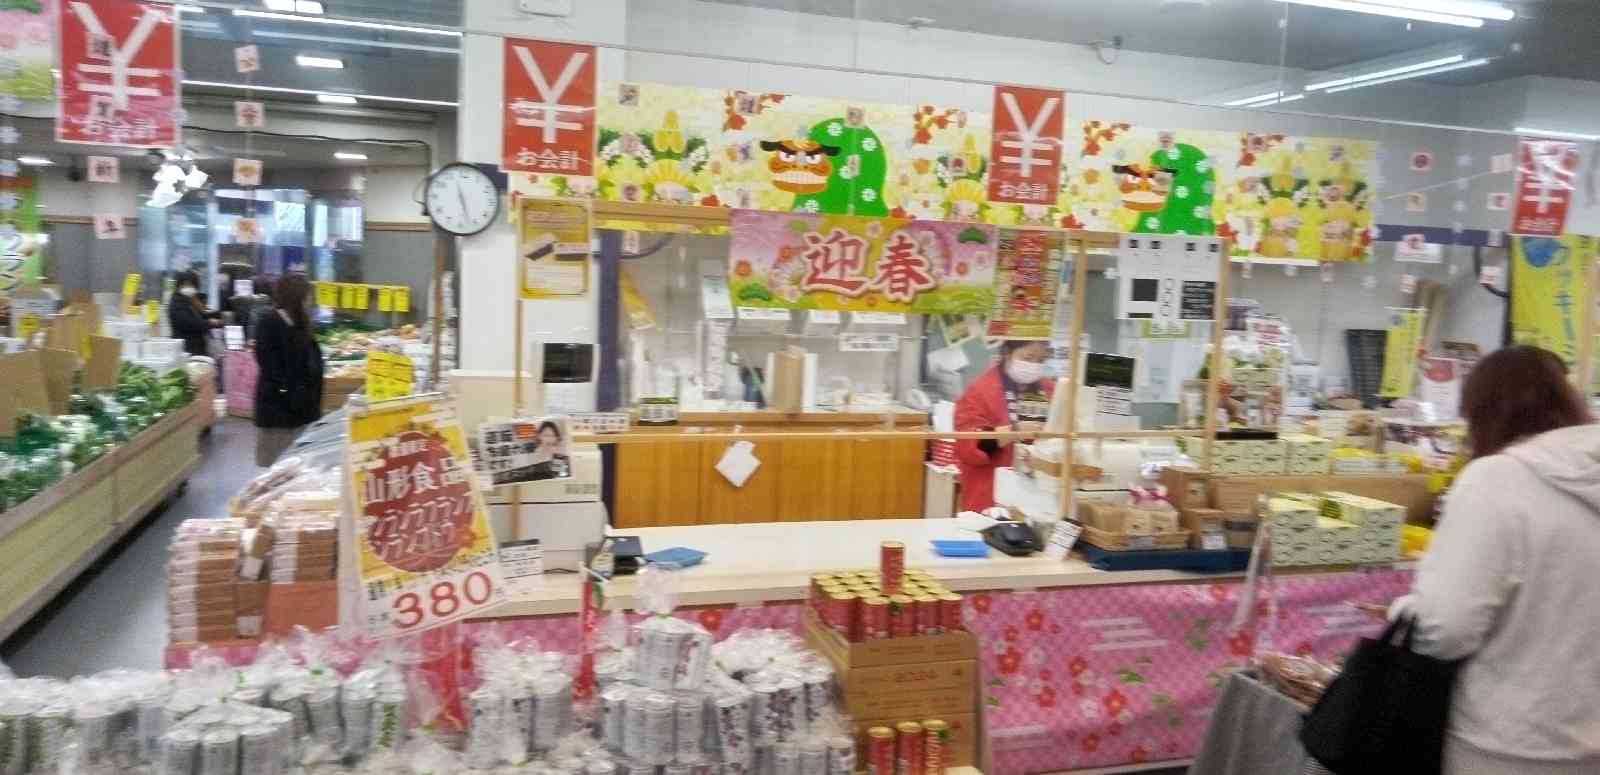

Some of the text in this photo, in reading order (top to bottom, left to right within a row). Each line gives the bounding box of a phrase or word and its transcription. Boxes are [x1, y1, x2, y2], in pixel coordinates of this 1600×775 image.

[68, 1, 164, 112] ¥
[511, 45, 589, 143] ¥
[515, 145, 579, 171] お会計
[1000, 92, 1060, 177] ¥
[997, 182, 1048, 201] お会計
[803, 230, 931, 298] 迎春
[363, 456, 460, 505] 山形食品
[392, 571, 493, 628] 380
